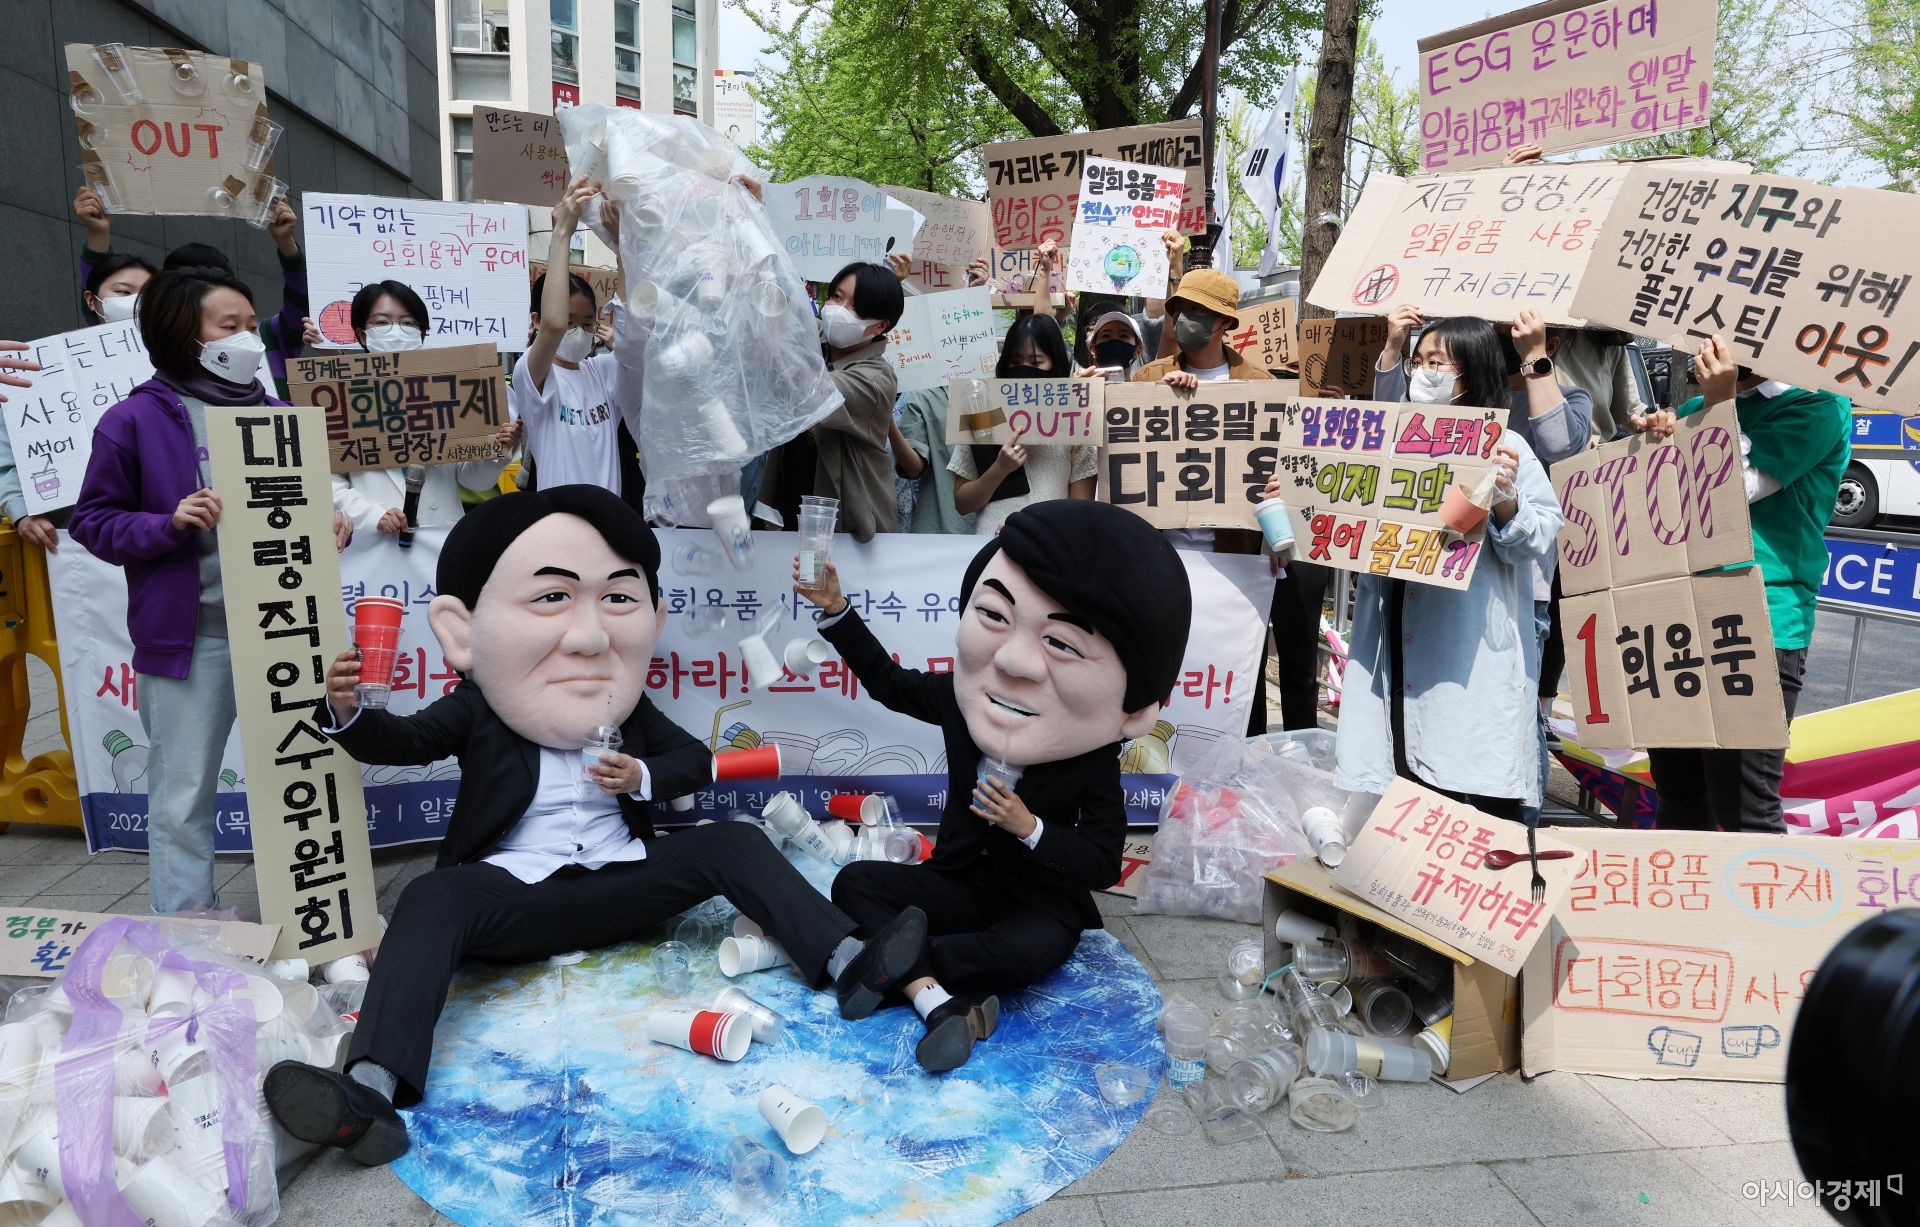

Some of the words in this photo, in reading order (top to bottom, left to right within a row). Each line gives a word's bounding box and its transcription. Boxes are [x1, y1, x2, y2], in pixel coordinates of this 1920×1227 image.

[1428, 32, 1511, 96] ESG
[1531, 3, 1658, 71] 운운하며
[486, 112, 523, 133] 만드는
[1631, 81, 1709, 132] 이냐!
[130, 119, 224, 159] OUT
[794, 186, 882, 222] 1회용이
[1403, 177, 1475, 213] 지금
[1638, 178, 1720, 225] 건강한
[1721, 183, 1843, 238] 지구와
[309, 206, 366, 235] 기약
[373, 206, 416, 236] 없는
[457, 213, 507, 237] 규제
[993, 193, 1079, 248] 일회용
[1403, 219, 1506, 259] 일회용품
[373, 240, 463, 269] 일회용컵
[480, 246, 527, 272] 유예
[1617, 228, 1692, 275] 건강한
[1693, 237, 1804, 298] 우리를
[1816, 264, 1913, 318] 위해
[423, 285, 470, 311] 핑계
[1424, 267, 1573, 304] 규제하라
[425, 317, 507, 338] 제까지
[941, 308, 985, 325] 인수위가
[1259, 307, 1286, 334] 일회
[1306, 325, 1337, 345] 매장
[1629, 273, 1782, 359] 플라스틱
[1795, 321, 1920, 396] 아웃!
[1262, 332, 1289, 365] 용컵
[21, 377, 135, 428] 사용하
[1000, 382, 1090, 408] 일회용품컵
[1009, 410, 1092, 437] OUT!
[1301, 406, 1386, 450] 일회용컵
[1855, 419, 1872, 436] 찰
[28, 437, 75, 464] 썩어
[340, 436, 381, 466] 지금
[388, 432, 447, 464] 당장!
[1315, 462, 1380, 506] 이제
[1384, 464, 1454, 514] 그만
[1561, 427, 1734, 568] STOP
[1309, 514, 1367, 561] 잊어
[235, 414, 353, 950] 대통령직인수위원회
[1576, 613, 1756, 725] 1회용품
[1374, 796, 1496, 871] 1회용품
[1569, 848, 1714, 912] 일회용품
[1739, 860, 1834, 911] 규제
[1411, 863, 1547, 942] 규제하라
[1567, 955, 1718, 1011] 다회용컵
[1667, 1042, 1697, 1063] cup
[1727, 1036, 1758, 1055] cup
